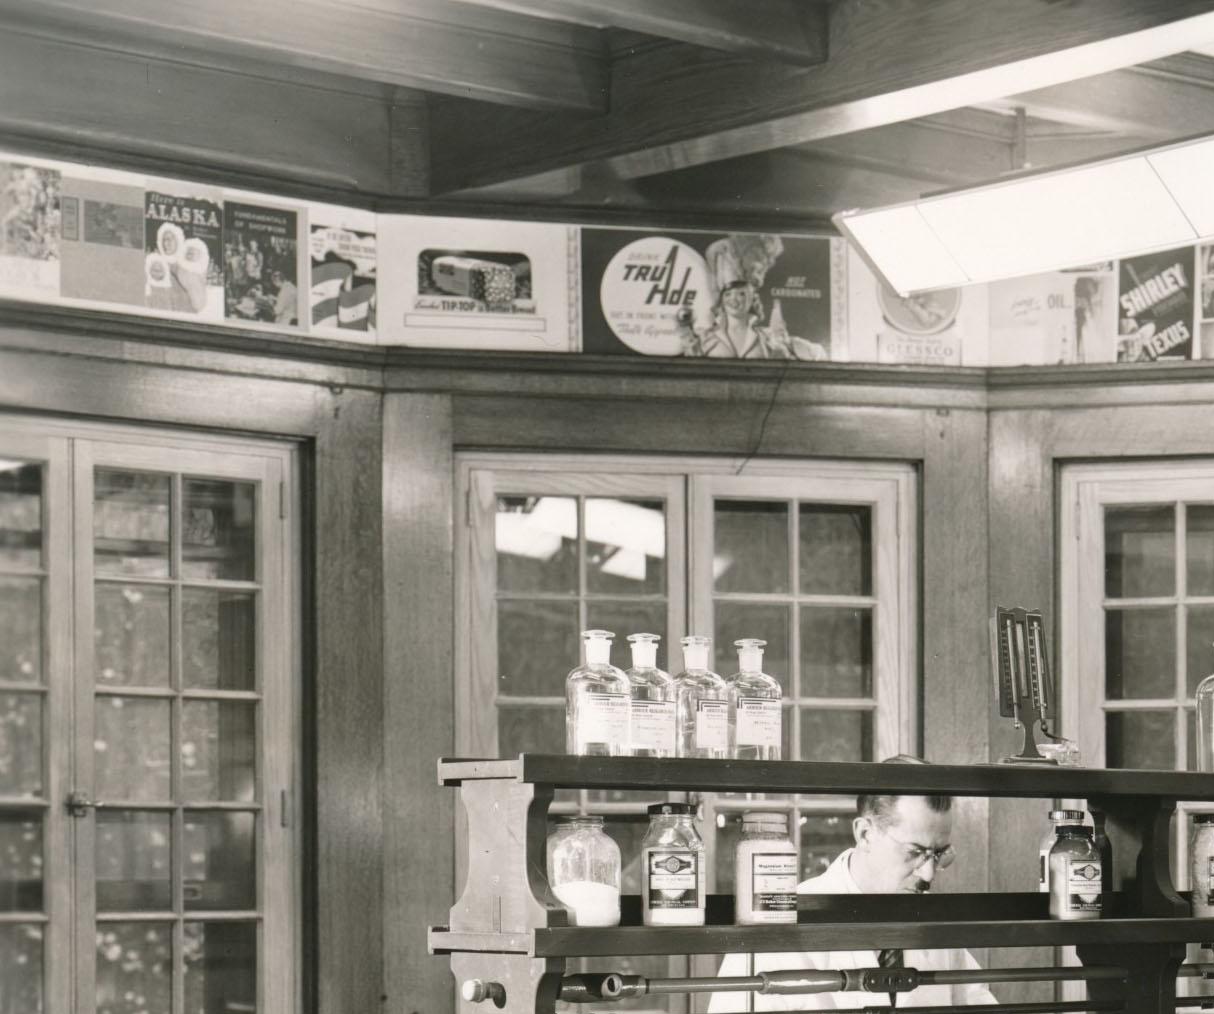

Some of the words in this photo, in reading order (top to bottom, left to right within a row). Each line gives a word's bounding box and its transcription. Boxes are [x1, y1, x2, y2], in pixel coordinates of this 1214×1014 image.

[145, 203, 220, 228] ALASKA
[233, 211, 287, 225] FUNDAMENTALS
[234, 219, 245, 228] OF
[248, 222, 286, 234] SHOPWORK
[628, 250, 661, 261] DRINK
[622, 263, 668, 282] TRU
[770, 287, 822, 299] CARBONATED
[1119, 263, 1188, 317] SHIRLEY
[1144, 320, 1190, 359] TEXUS
[886, 343, 953, 356] GLESSCO
